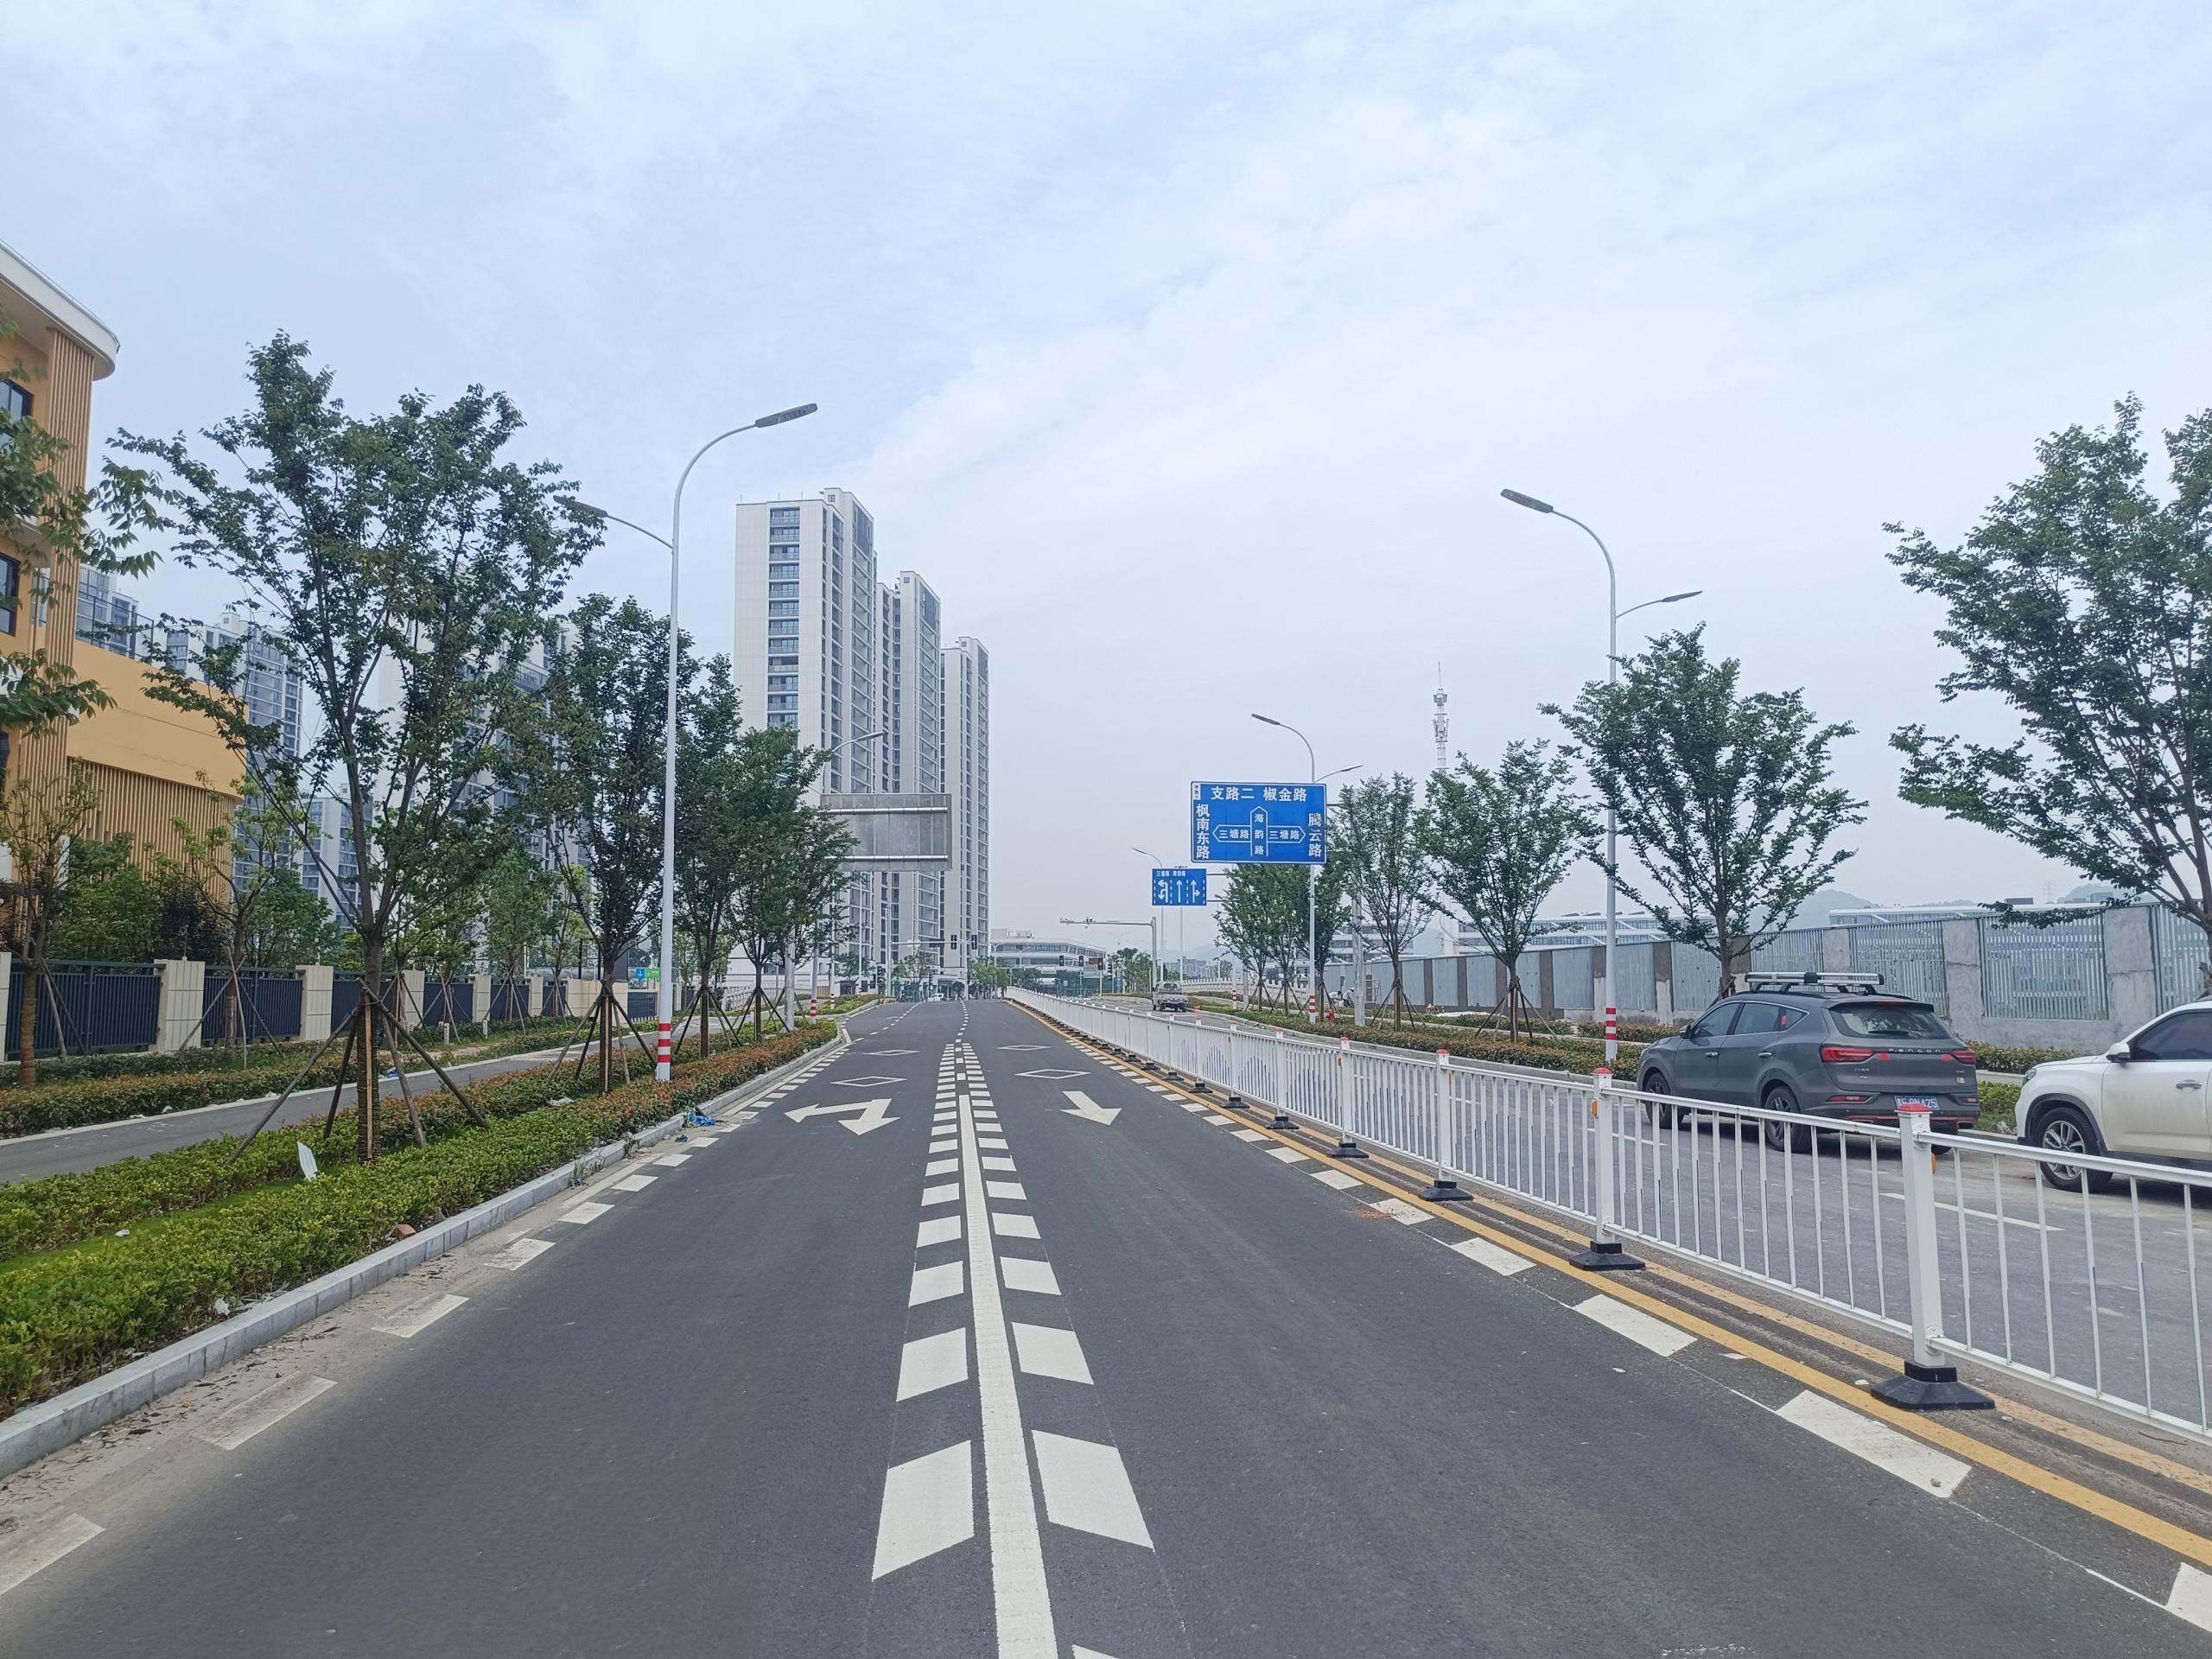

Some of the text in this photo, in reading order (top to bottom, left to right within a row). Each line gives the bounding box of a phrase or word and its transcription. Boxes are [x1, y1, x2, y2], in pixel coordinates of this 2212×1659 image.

[1211, 786, 1255, 800] 支路二
[1263, 787, 1307, 802] 椒金路
[1196, 804, 1210, 859] 枫南东路
[1218, 829, 1249, 839] 三塘路
[1254, 813, 1264, 855] 海韵路
[1269, 830, 1300, 841] 三塘路
[1308, 813, 1323, 858] 腾云路
